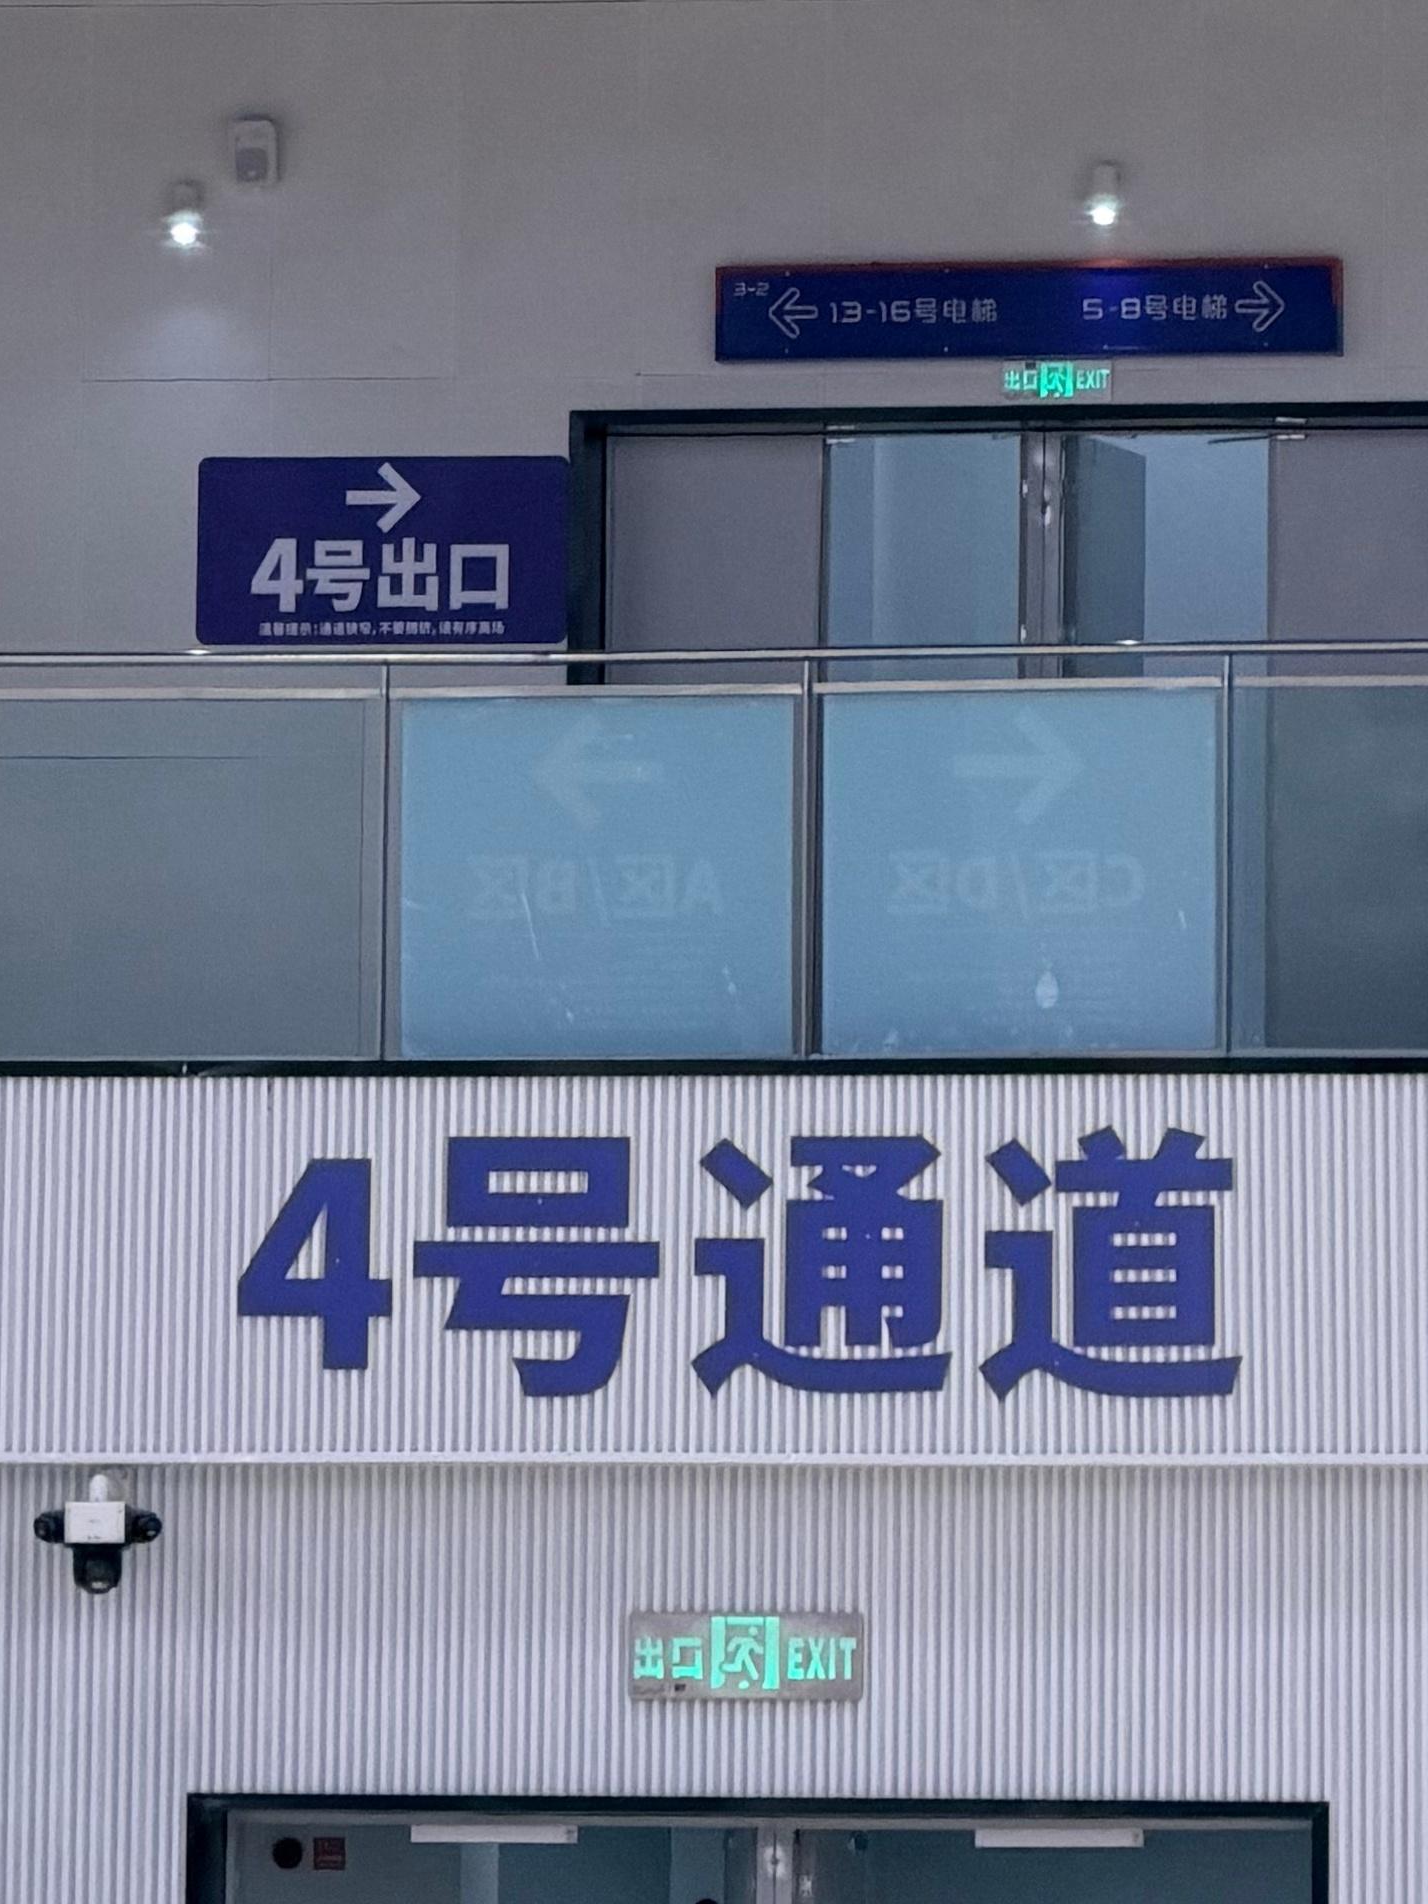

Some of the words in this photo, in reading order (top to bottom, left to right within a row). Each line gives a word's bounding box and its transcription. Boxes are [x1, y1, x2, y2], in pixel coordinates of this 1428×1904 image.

[829, 297, 997, 324] 13-16号电梯
[1082, 294, 1227, 321] 5-8号电梯
[1004, 369, 1037, 390] 出口
[1076, 368, 1110, 390] EXIT
[250, 537, 510, 613] 4号出口
[236, 1125, 1242, 1401] 4号通道
[633, 1635, 704, 1680] 出口
[787, 1637, 857, 1680] EXIT
